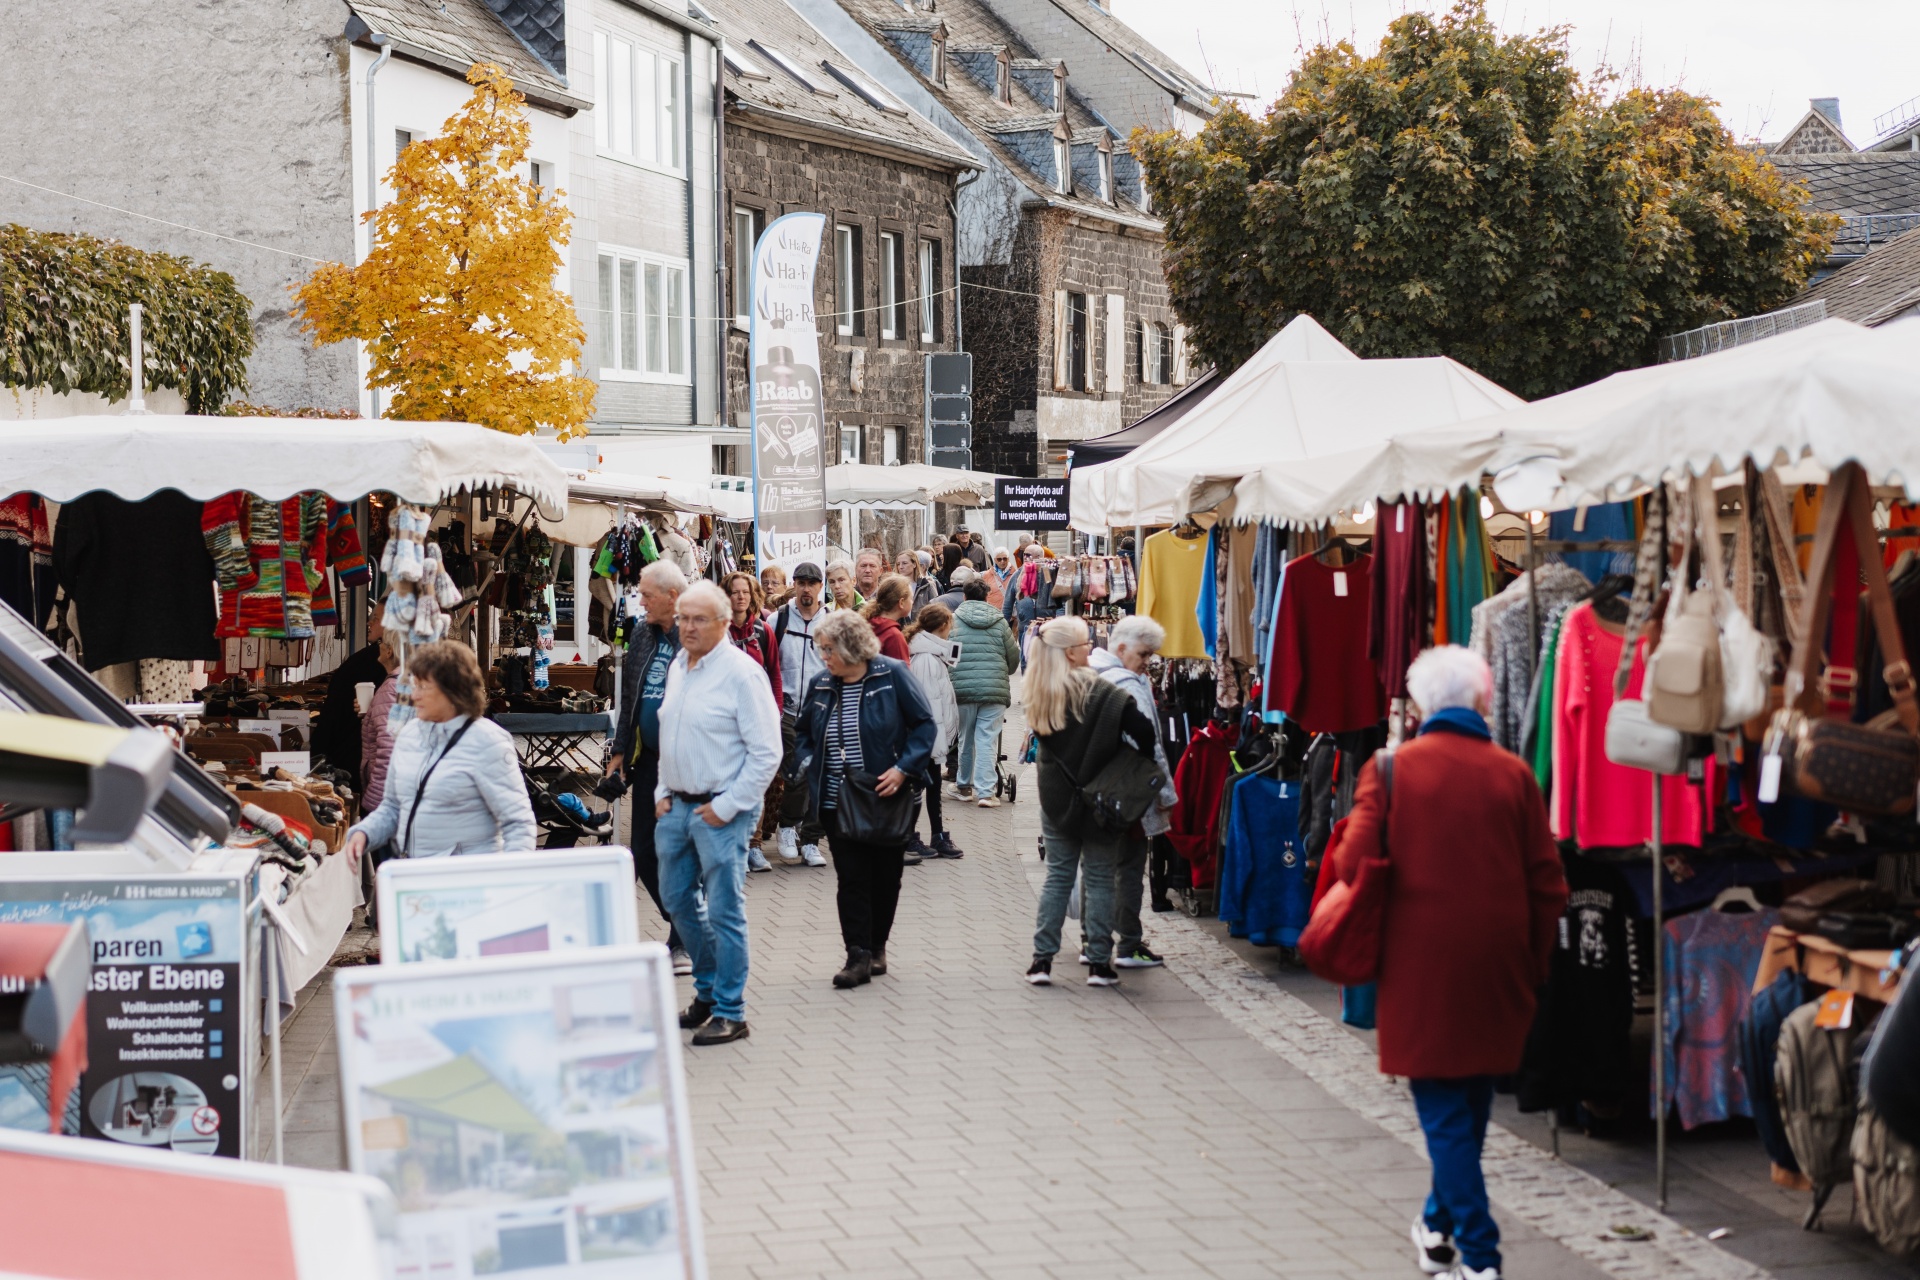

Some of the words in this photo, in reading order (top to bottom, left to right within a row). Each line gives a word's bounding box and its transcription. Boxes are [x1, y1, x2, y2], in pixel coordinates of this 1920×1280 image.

[760, 379, 814, 401] Raab
[1004, 485, 1014, 495] Ihr
[1015, 484, 1051, 497] Handyfoto
[1052, 484, 1064, 495] auf
[1009, 499, 1029, 508] unser
[1029, 498, 1057, 508] Produkt
[1000, 510, 1008, 520] in
[1008, 510, 1038, 523] wenigen
[1038, 510, 1067, 521] Minuten
[148, 887, 177, 898] HEIM
[93, 939, 163, 963] paren
[149, 965, 225, 990] Ebene
[121, 1001, 204, 1015] Vollkunststoff-
[106, 1017, 204, 1030] Wohndachfenster
[132, 1032, 204, 1046] Schallschutz
[119, 1048, 204, 1061] Insektenschutz
